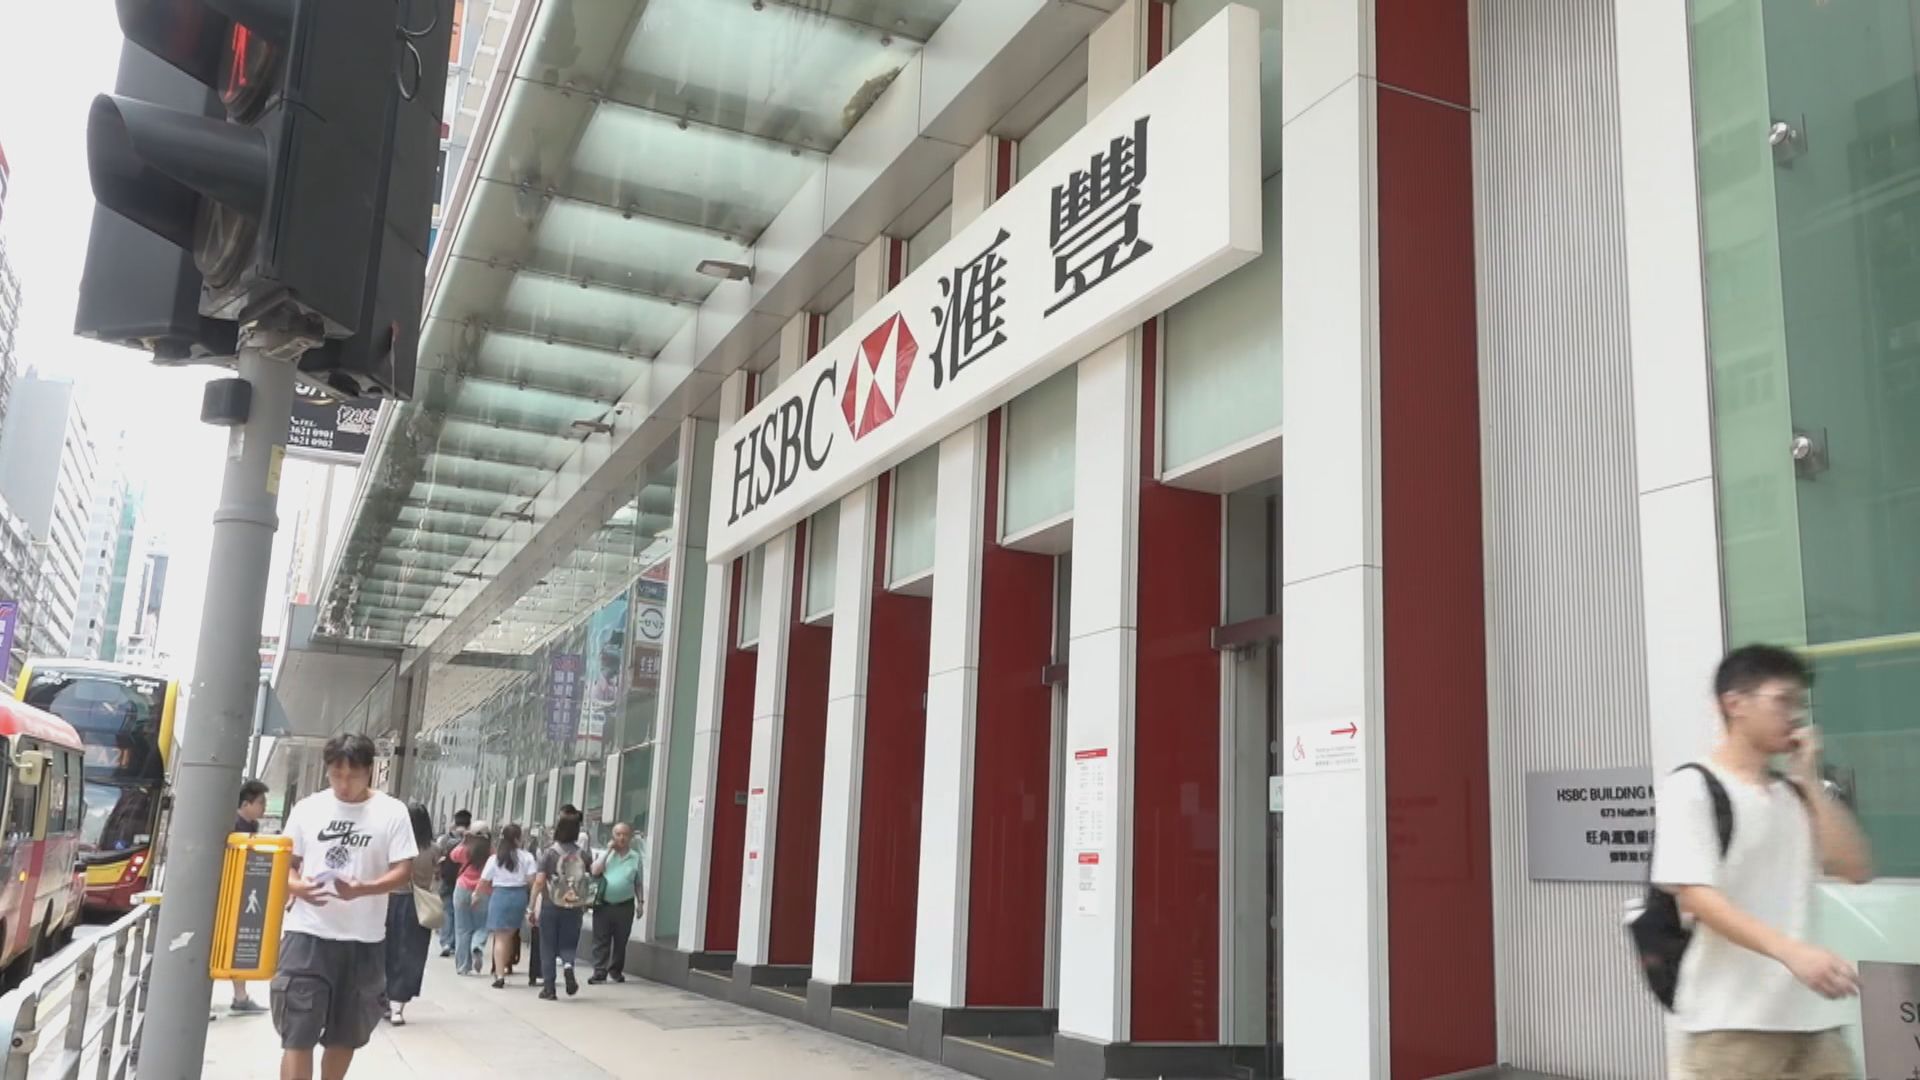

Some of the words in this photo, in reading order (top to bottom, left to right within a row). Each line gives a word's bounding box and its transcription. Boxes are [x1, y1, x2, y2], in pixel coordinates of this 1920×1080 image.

[728, 360, 837, 527] HSBC
[1557, 788, 1588, 802] HSBC
[1590, 785, 1646, 801] BUILDING
[326, 820, 356, 834] JUST
[1900, 1001, 1920, 1023] S
